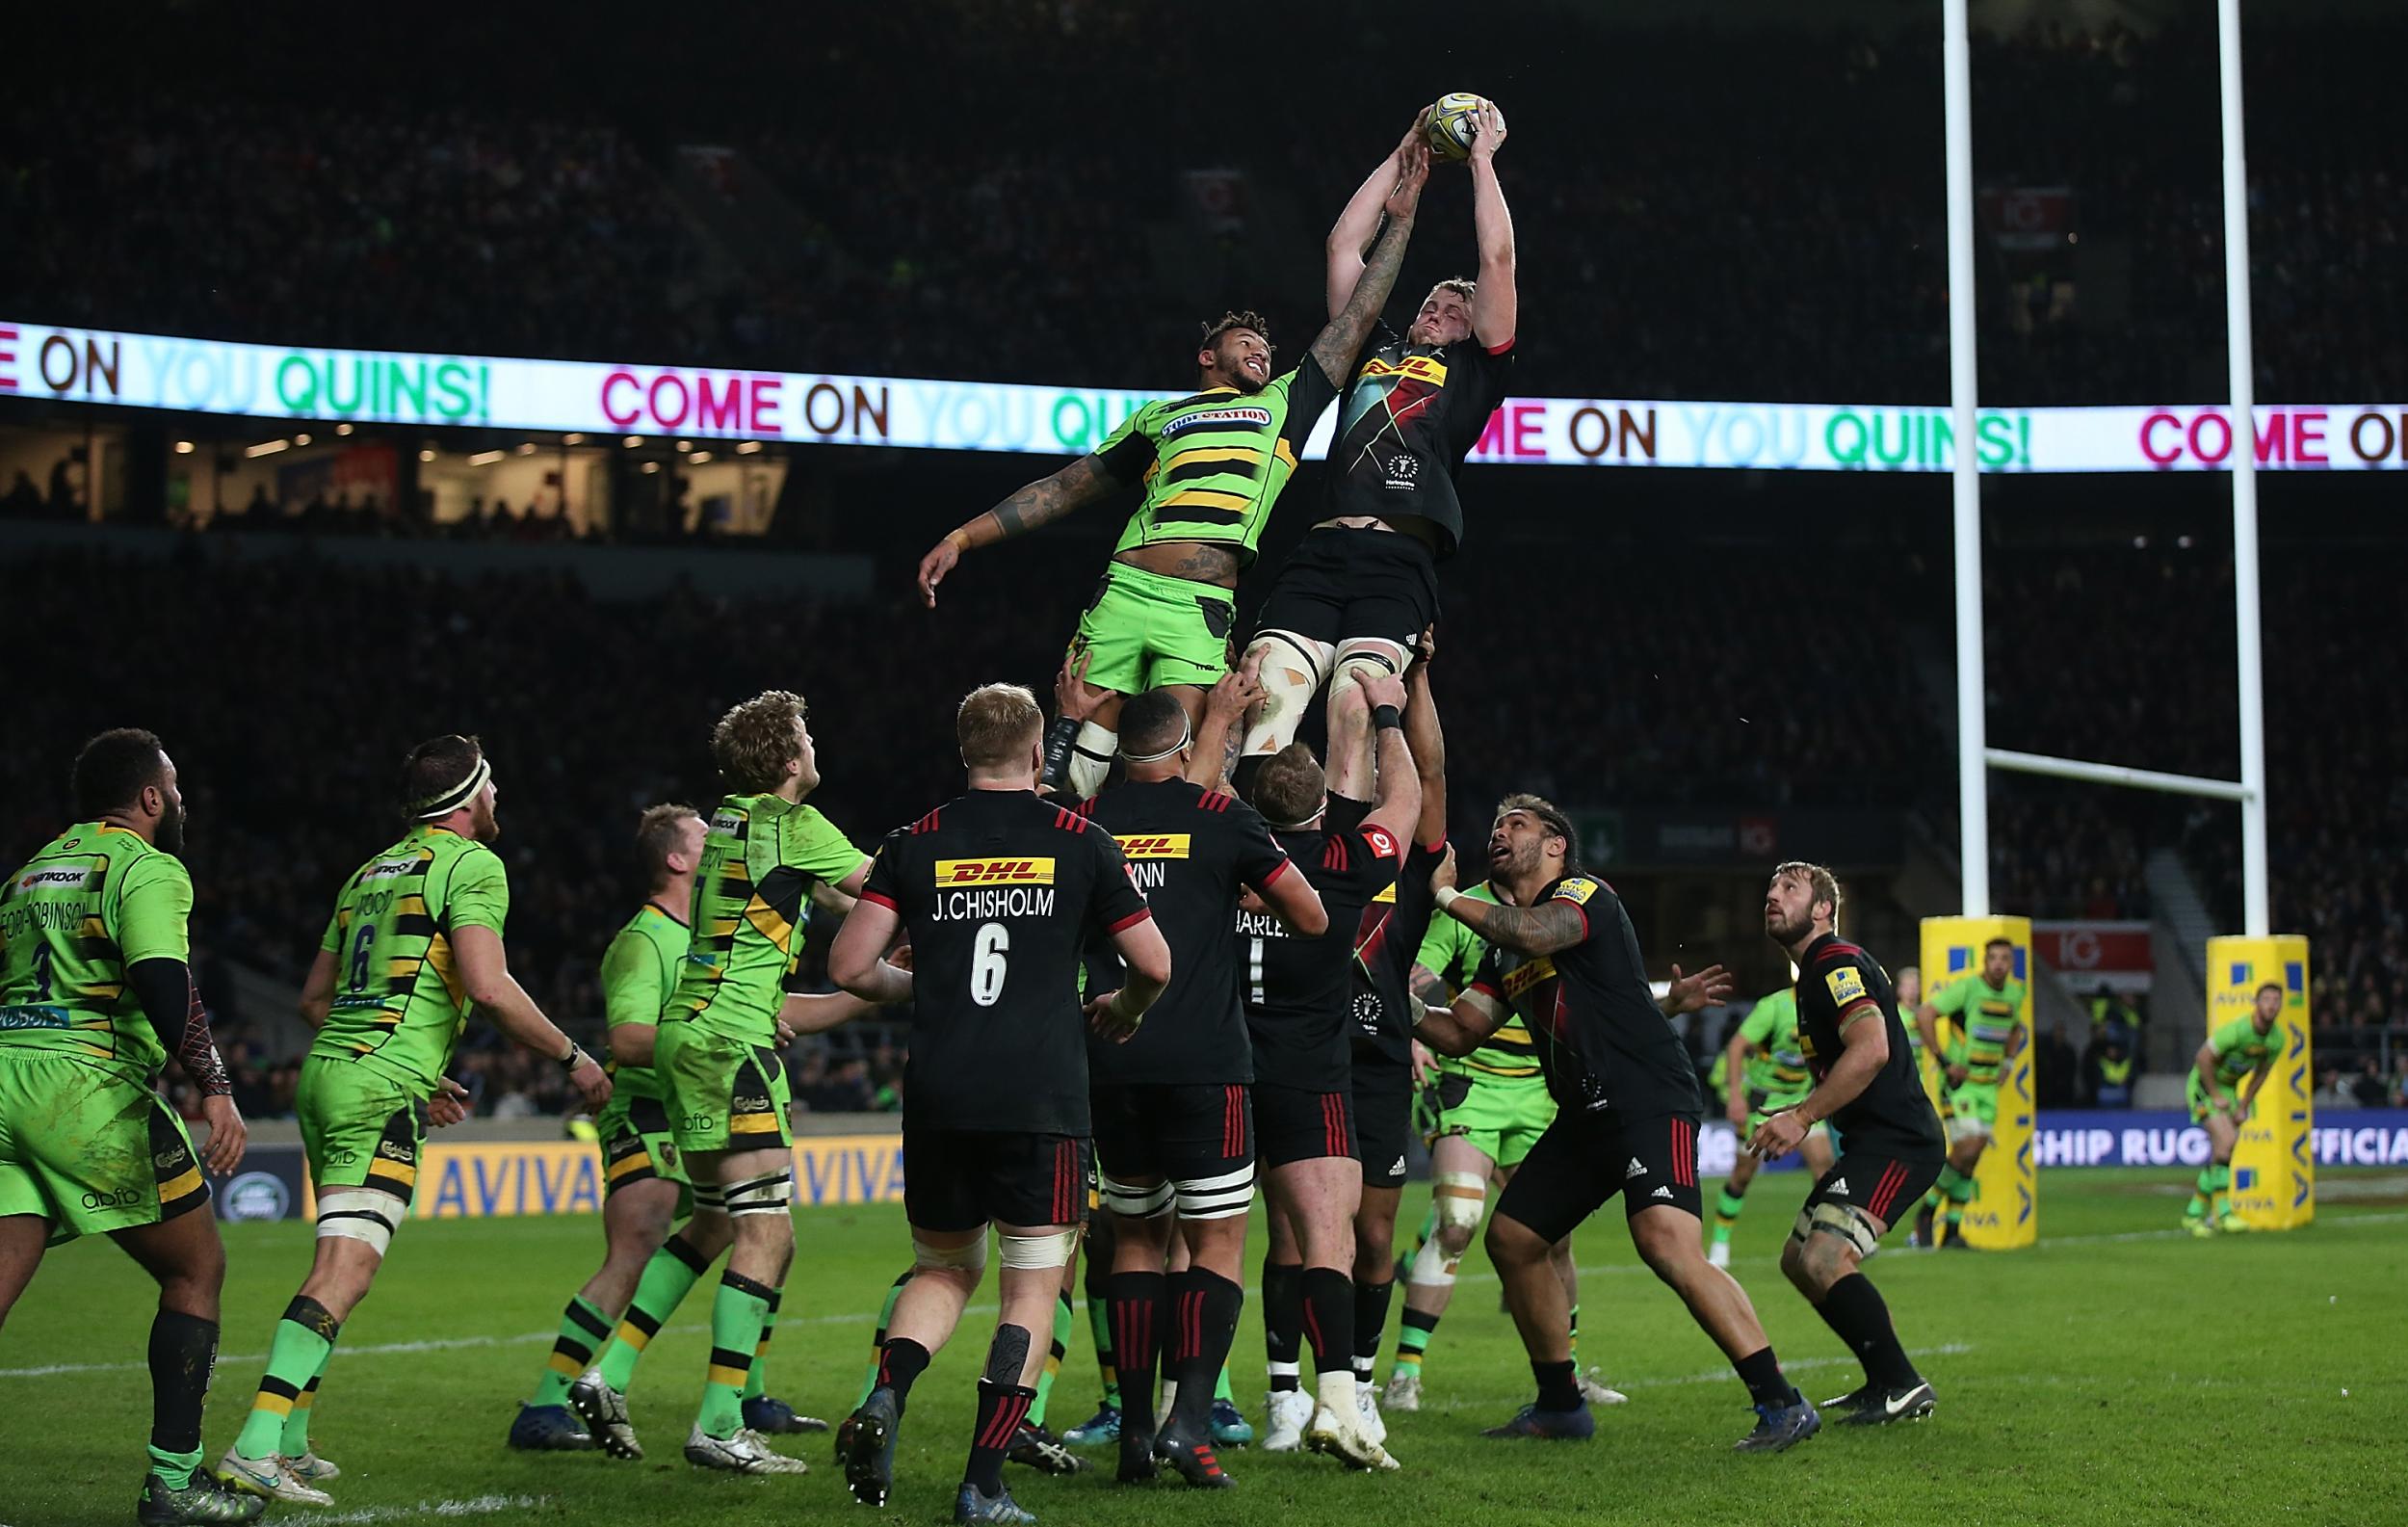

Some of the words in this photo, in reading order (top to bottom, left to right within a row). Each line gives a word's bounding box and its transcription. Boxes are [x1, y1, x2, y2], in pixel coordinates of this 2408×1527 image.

[39, 334, 118, 395] ON
[145, 343, 259, 410] YOU
[275, 355, 491, 421] QUINS!
[601, 372, 781, 433] COME
[805, 382, 888, 437] ON
[914, 389, 1033, 447] YOU
[1569, 407, 1656, 459] ON
[1684, 409, 1807, 464] YOU
[2140, 412, 2329, 463] COME
[2350, 411, 2408, 462] O
[931, 887, 1056, 921] J.CHISHOLM
[952, 861, 1037, 882] DHL
[349, 924, 377, 992] 6
[970, 921, 1010, 1008] 6
[1249, 937, 1265, 1005] 1
[2288, 1021, 2308, 1209] AVIVA
[432, 1157, 599, 1217] AVIVA
